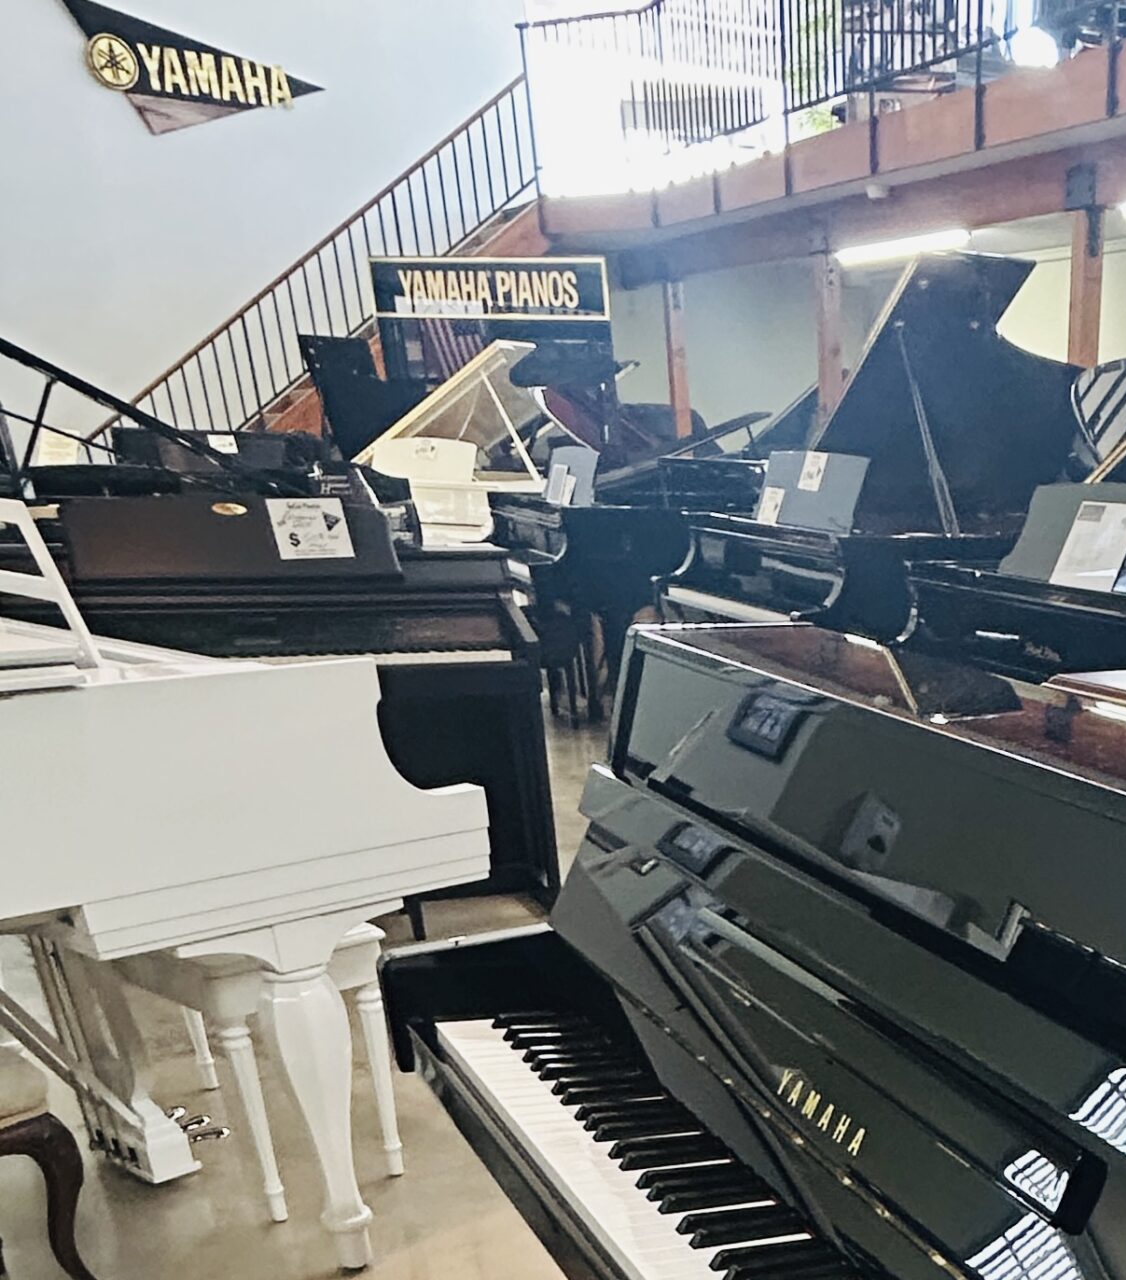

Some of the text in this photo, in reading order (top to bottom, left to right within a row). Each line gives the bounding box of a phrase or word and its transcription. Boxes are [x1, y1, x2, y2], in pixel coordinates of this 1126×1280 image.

[136, 43, 292, 108] YAMAHA
[397, 269, 579, 309] YAMAHA PIANOS
[777, 1069, 866, 1156] YAMAHA
